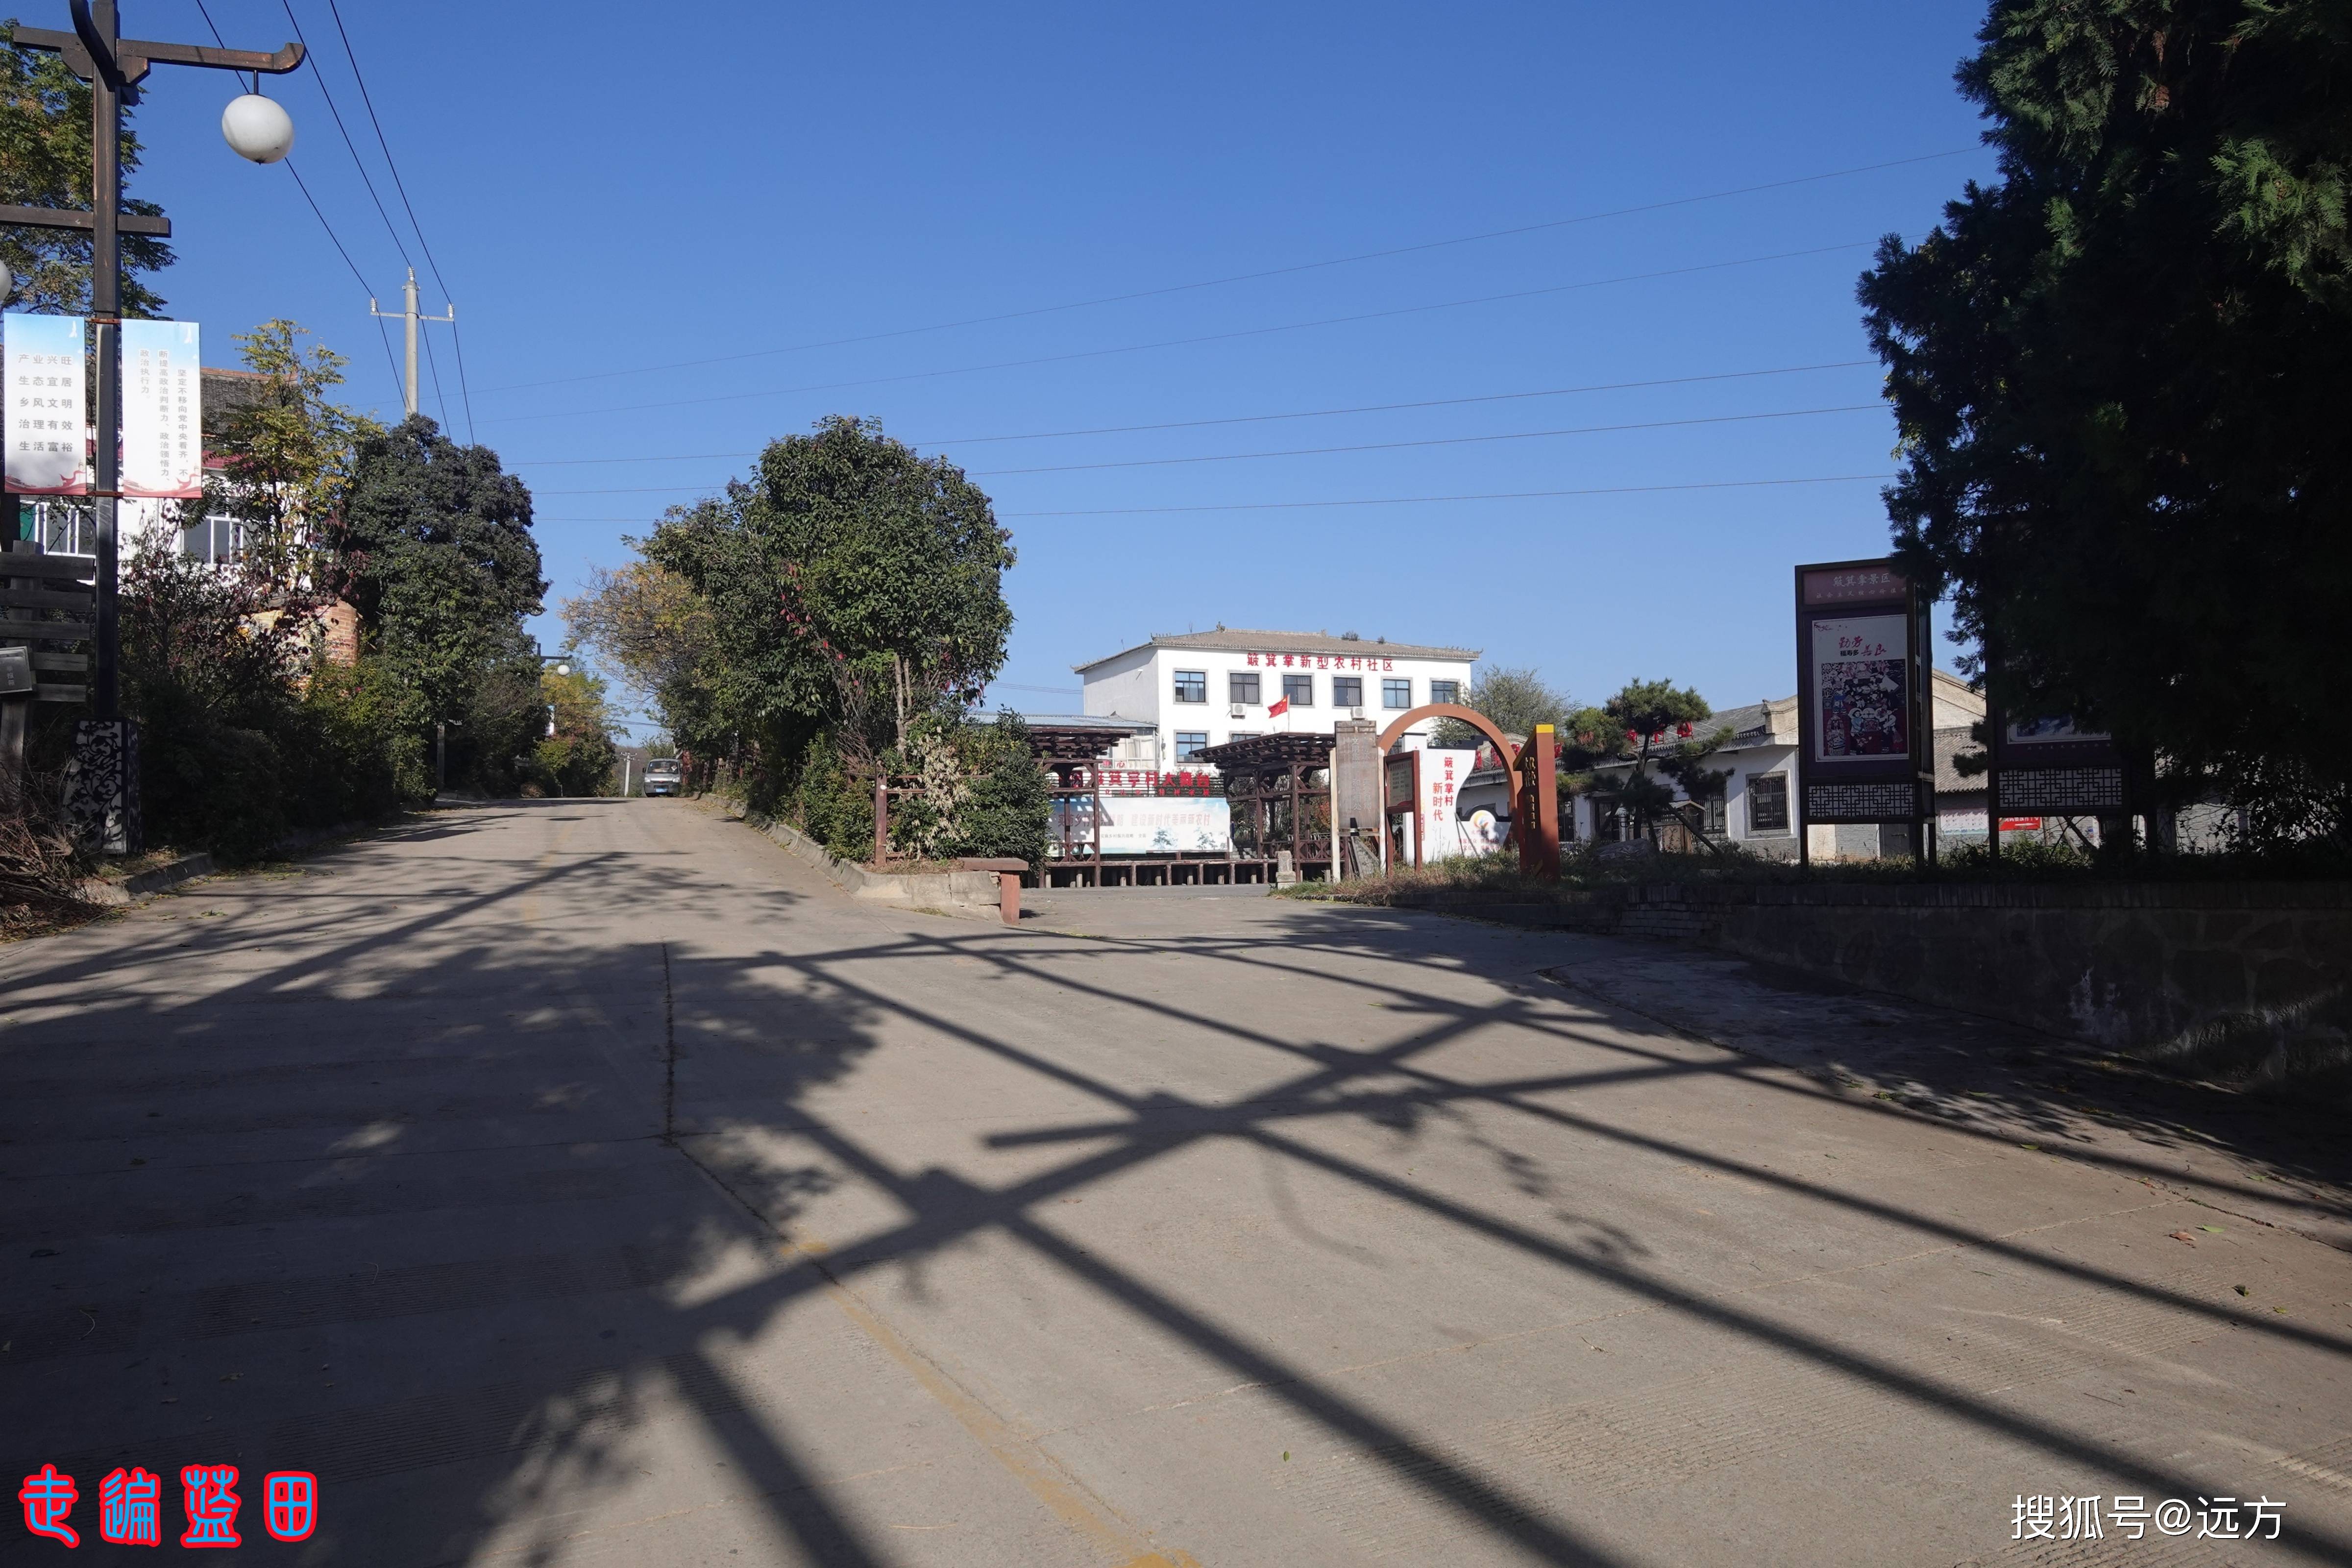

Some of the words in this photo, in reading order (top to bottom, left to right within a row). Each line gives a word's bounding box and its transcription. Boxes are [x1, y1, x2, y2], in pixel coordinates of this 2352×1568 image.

[18, 353, 72, 365] 产业兴旺
[18, 376, 72, 388] 生态宜居
[19, 397, 73, 409] 乡风文明
[19, 419, 73, 431] 治理有效
[19, 441, 73, 452] 生活富裕
[1247, 652, 1393, 671] 簸箕掌新型农村社区
[1444, 757, 1454, 806] 簸箕掌村
[1433, 782, 1443, 821] 新时代
